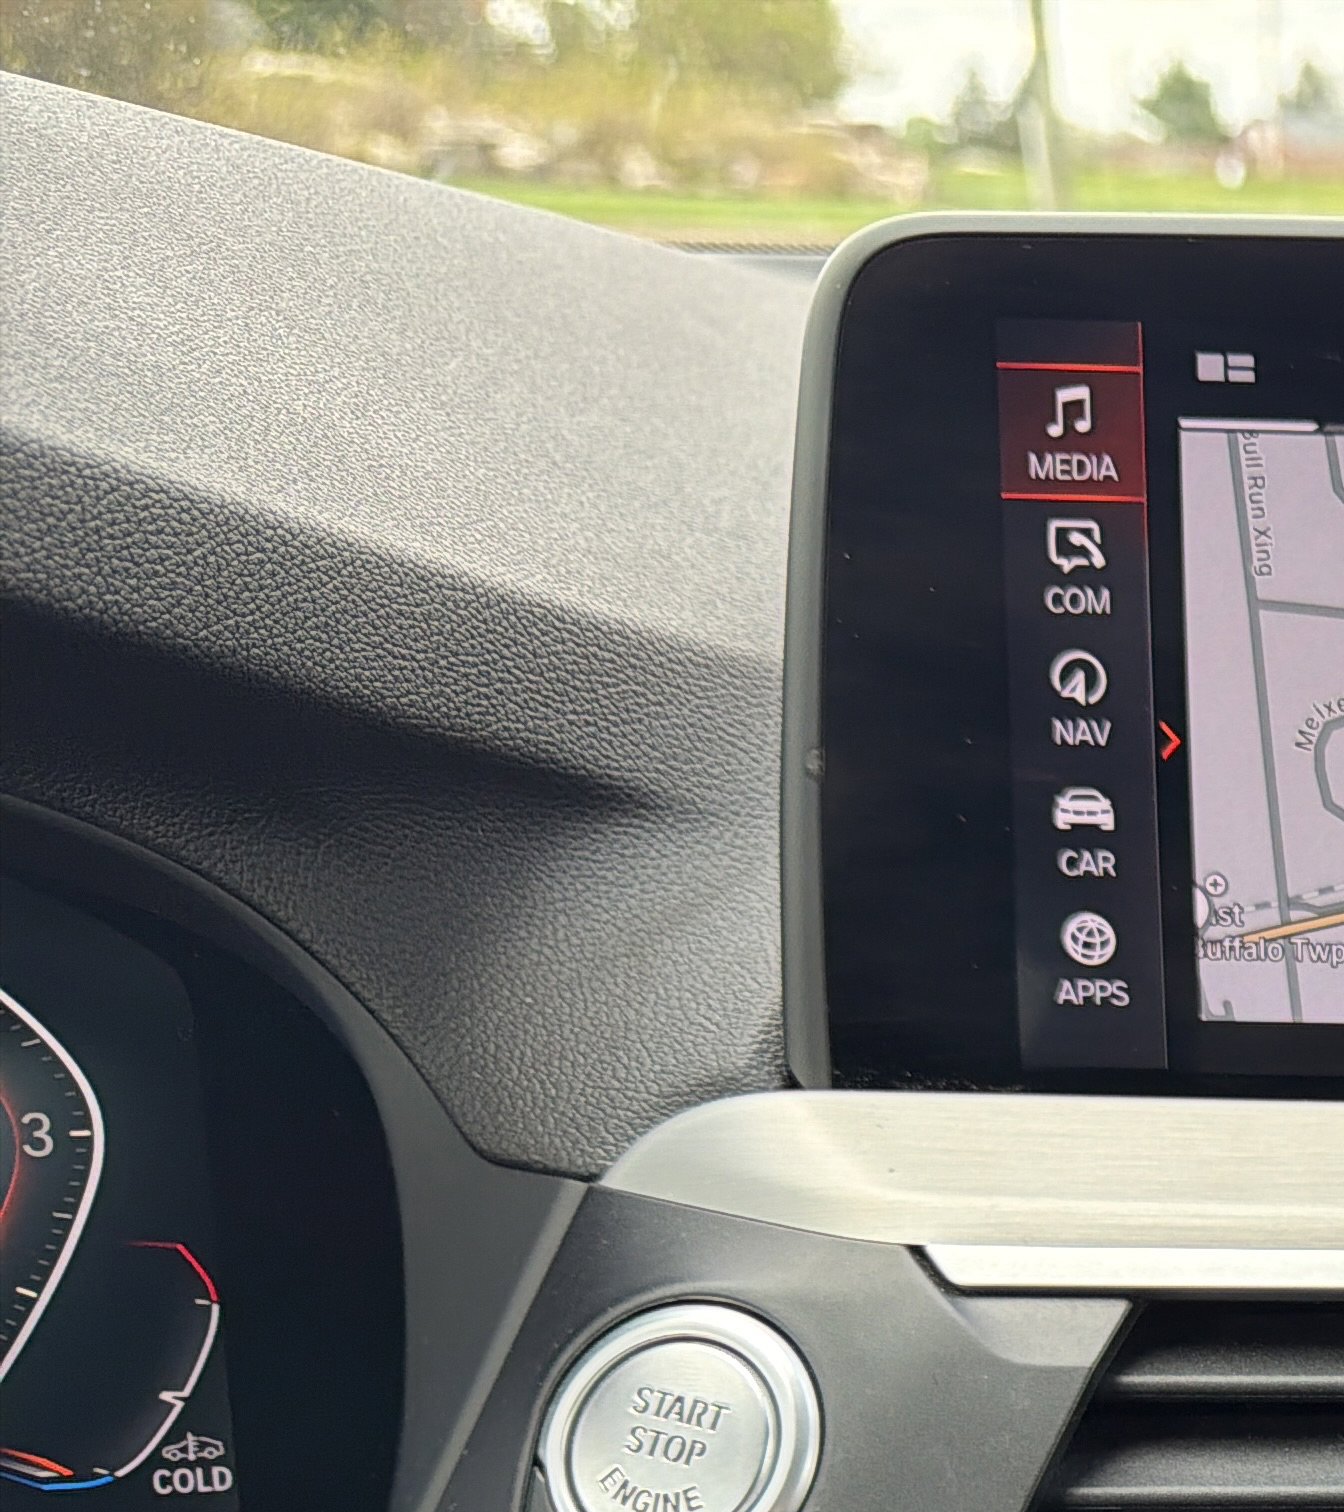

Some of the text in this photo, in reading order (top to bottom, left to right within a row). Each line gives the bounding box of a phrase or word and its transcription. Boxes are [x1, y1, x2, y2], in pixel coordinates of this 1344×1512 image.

[1028, 451, 1120, 483] MEDIA
[1241, 431, 1273, 577] Bull Run Xing
[1043, 585, 1111, 615] COM
[1051, 717, 1112, 747] NAV
[1056, 848, 1117, 878] CAR
[1054, 979, 1130, 1008] APPS
[21, 1111, 55, 1158] 3
[631, 1386, 732, 1434] START
[624, 1425, 708, 1467] STOP
[152, 1466, 234, 1495] COLD
